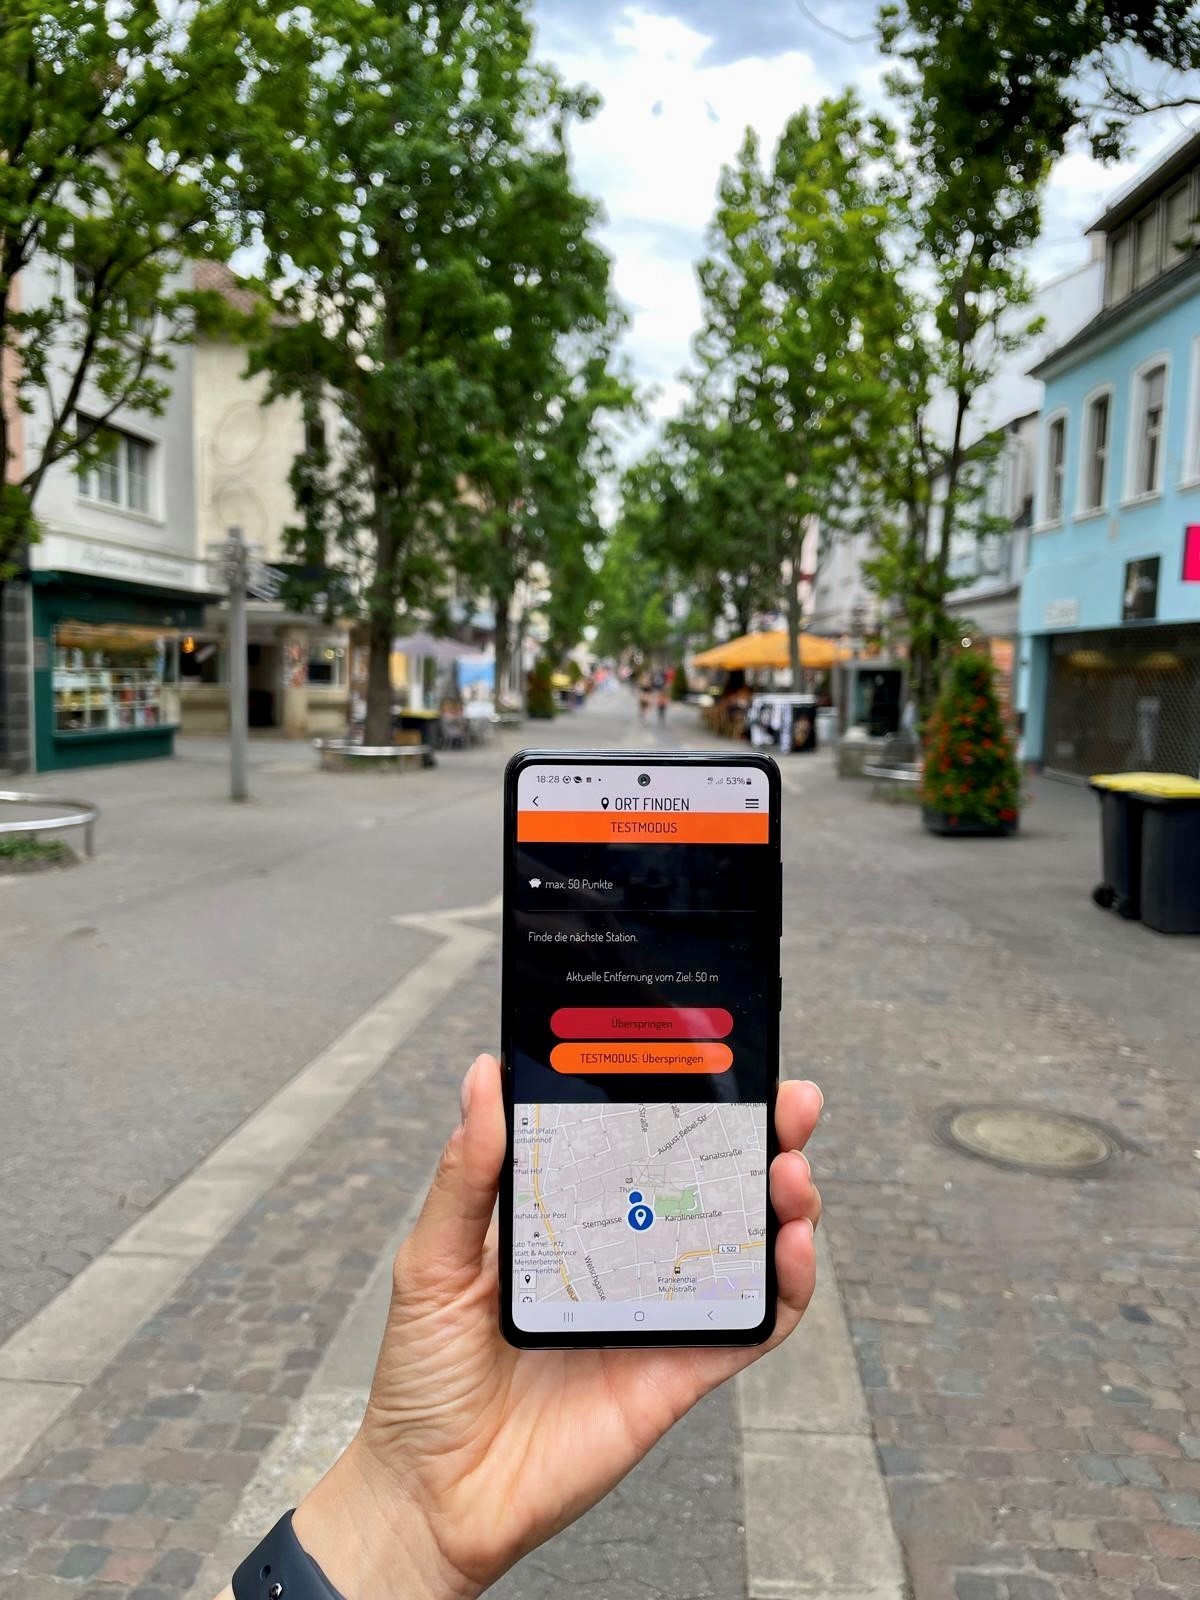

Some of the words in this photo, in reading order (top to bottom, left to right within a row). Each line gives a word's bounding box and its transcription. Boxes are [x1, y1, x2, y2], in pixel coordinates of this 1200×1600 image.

[536, 775, 560, 784] 18:28
[726, 777, 746, 785] 53%
[614, 797, 640, 811] ORT
[643, 798, 690, 812] FINDEN
[610, 821, 678, 834] TESTMODUS
[567, 879, 580, 890] 50
[582, 879, 614, 890] Punkte
[528, 931, 553, 942] Finde
[554, 931, 568, 942] die
[569, 932, 604, 943] nächste
[605, 931, 639, 942] Station.
[565, 971, 602, 983] Aktuelle
[603, 971, 654, 985] Entfernung
[654, 974, 675, 983] vom
[675, 971, 694, 983] Ziel:
[694, 971, 708, 983] 50
[709, 974, 719, 983] m
[611, 1016, 673, 1031] Überspringen
[579, 1053, 640, 1064] TESTMODUS:
[642, 1052, 704, 1066] Überspringen
[700, 1148, 743, 1162] Kanalstraße
[582, 1216, 622, 1229] Sterngasse
[664, 1210, 722, 1222] Karolinenstraße
[657, 1276, 698, 1284] Frankenthal
